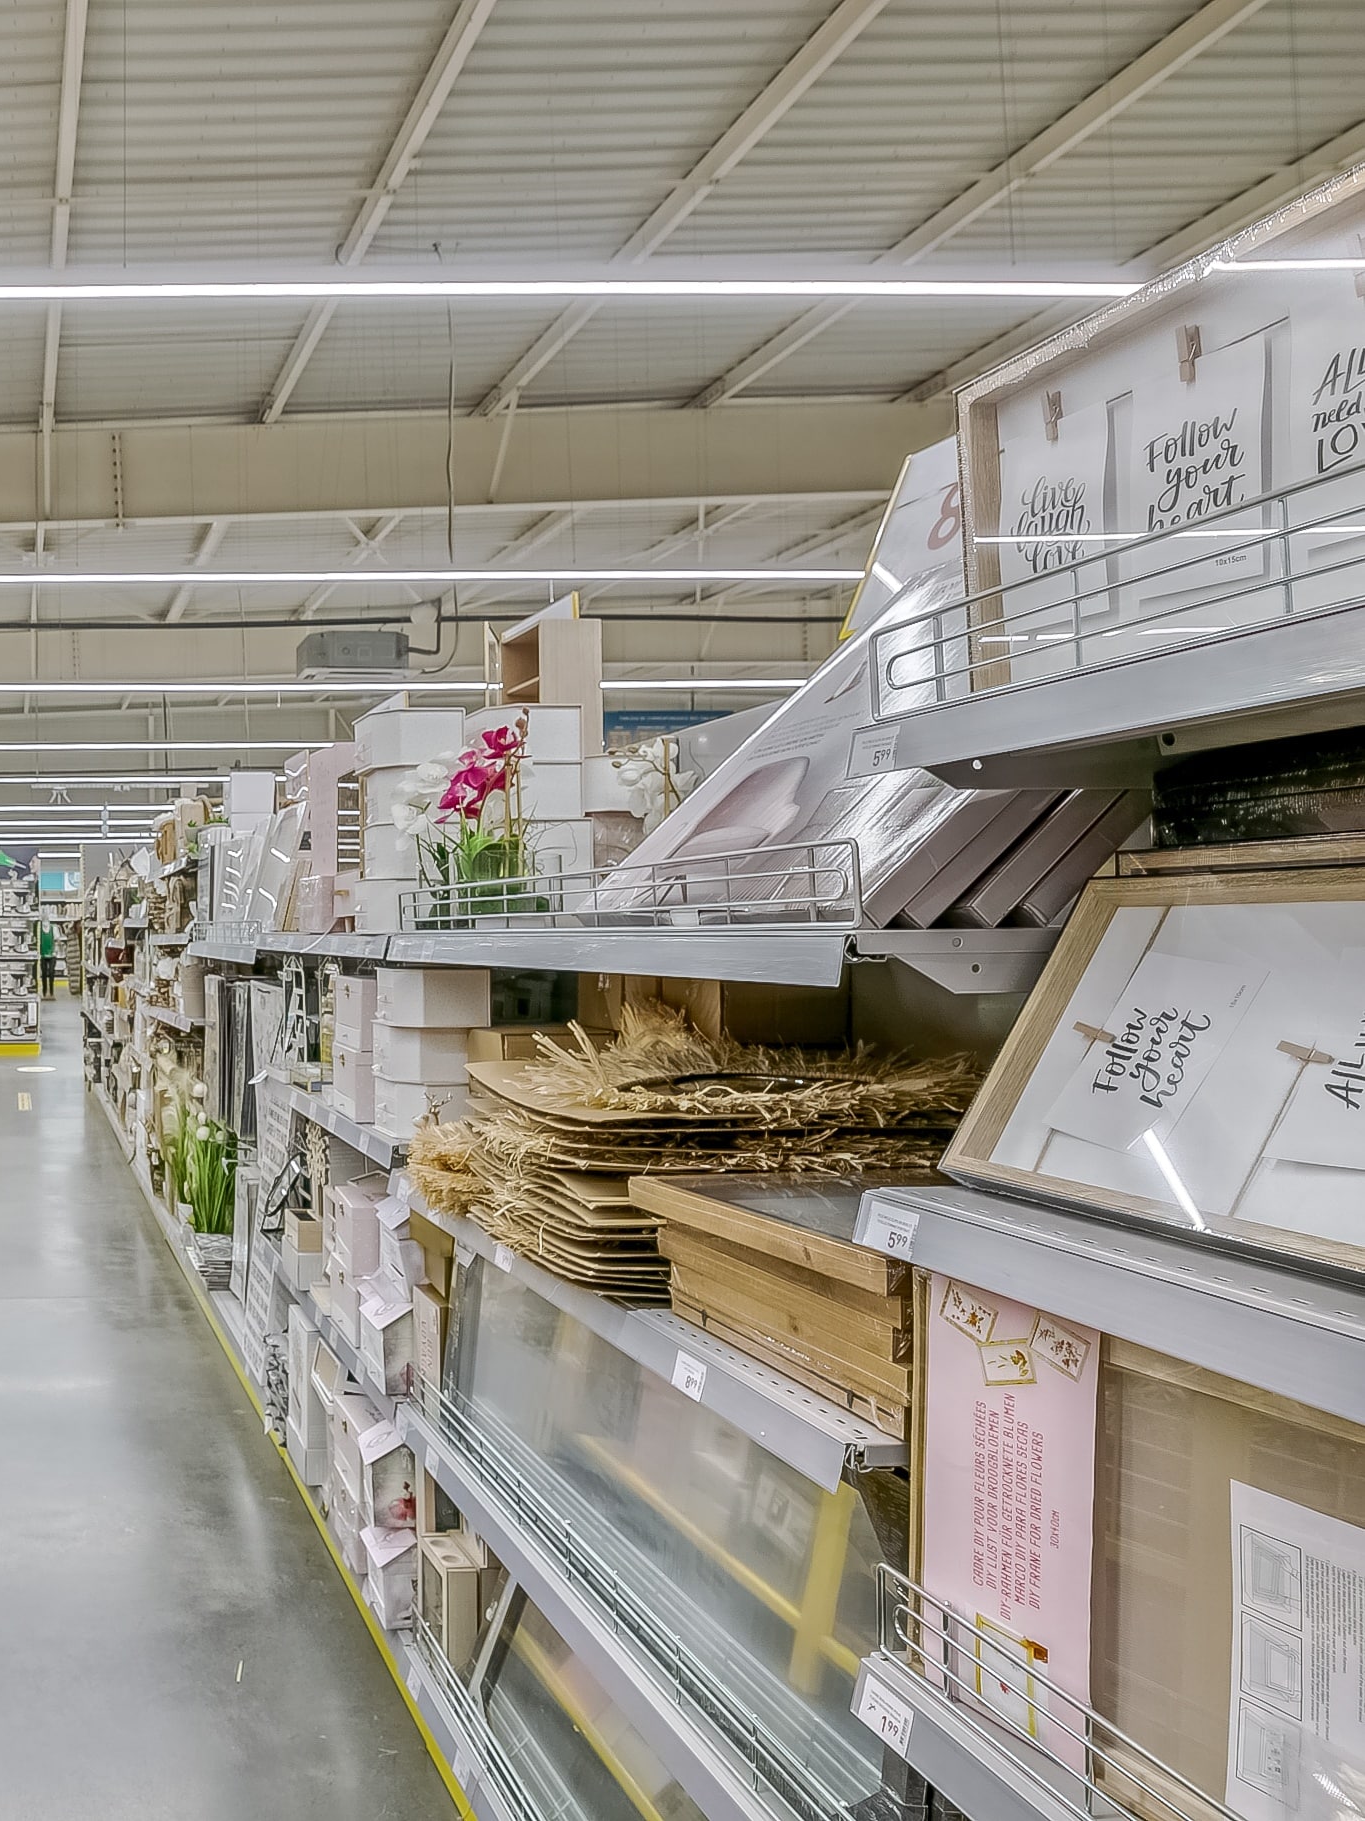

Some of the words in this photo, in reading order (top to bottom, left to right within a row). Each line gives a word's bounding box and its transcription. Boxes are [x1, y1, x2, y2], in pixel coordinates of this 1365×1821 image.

[1144, 407, 1238, 473] Follow
[1317, 423, 1365, 474] LO
[1021, 475, 1076, 518] live
[1157, 438, 1245, 513] your
[1092, 1007, 1148, 1094] Follow
[1129, 1007, 1179, 1092] your
[1139, 1010, 1211, 1108] heart
[887, 1231, 908, 1249] 599
[973, 1400, 987, 1450] SÉCHÉES
[1003, 1392, 1016, 1440] BLUMEN
[987, 1409, 1000, 1500] DROOGBLOEMEN
[1016, 1421, 1029, 1459] SECAS
[1030, 1431, 1044, 1486] FLOWERS
[974, 1451, 986, 1494] FLEURS
[1001, 1440, 1014, 1522] GETROCKNETE
[1016, 1461, 1028, 1506] FLORES
[973, 1495, 985, 1527] POUR
[986, 1502, 999, 1533] VOOR
[1015, 1507, 1027, 1541] PARA
[1030, 1488, 1042, 1521] DRIED
[974, 1527, 985, 1547] DIY
[999, 1524, 1013, 1549] FÜR
[1015, 1541, 1027, 1561] DIY
[1030, 1523, 1041, 1549] FOR
[972, 1548, 985, 1587] CADRE
[986, 1570, 998, 1590] DIY
[1000, 1549, 1012, 1621] DIY-RAHMEN
[1014, 1563, 1026, 1606] MARCO
[1029, 1589, 1040, 1610] DIY
[881, 1715, 899, 1737] 199
